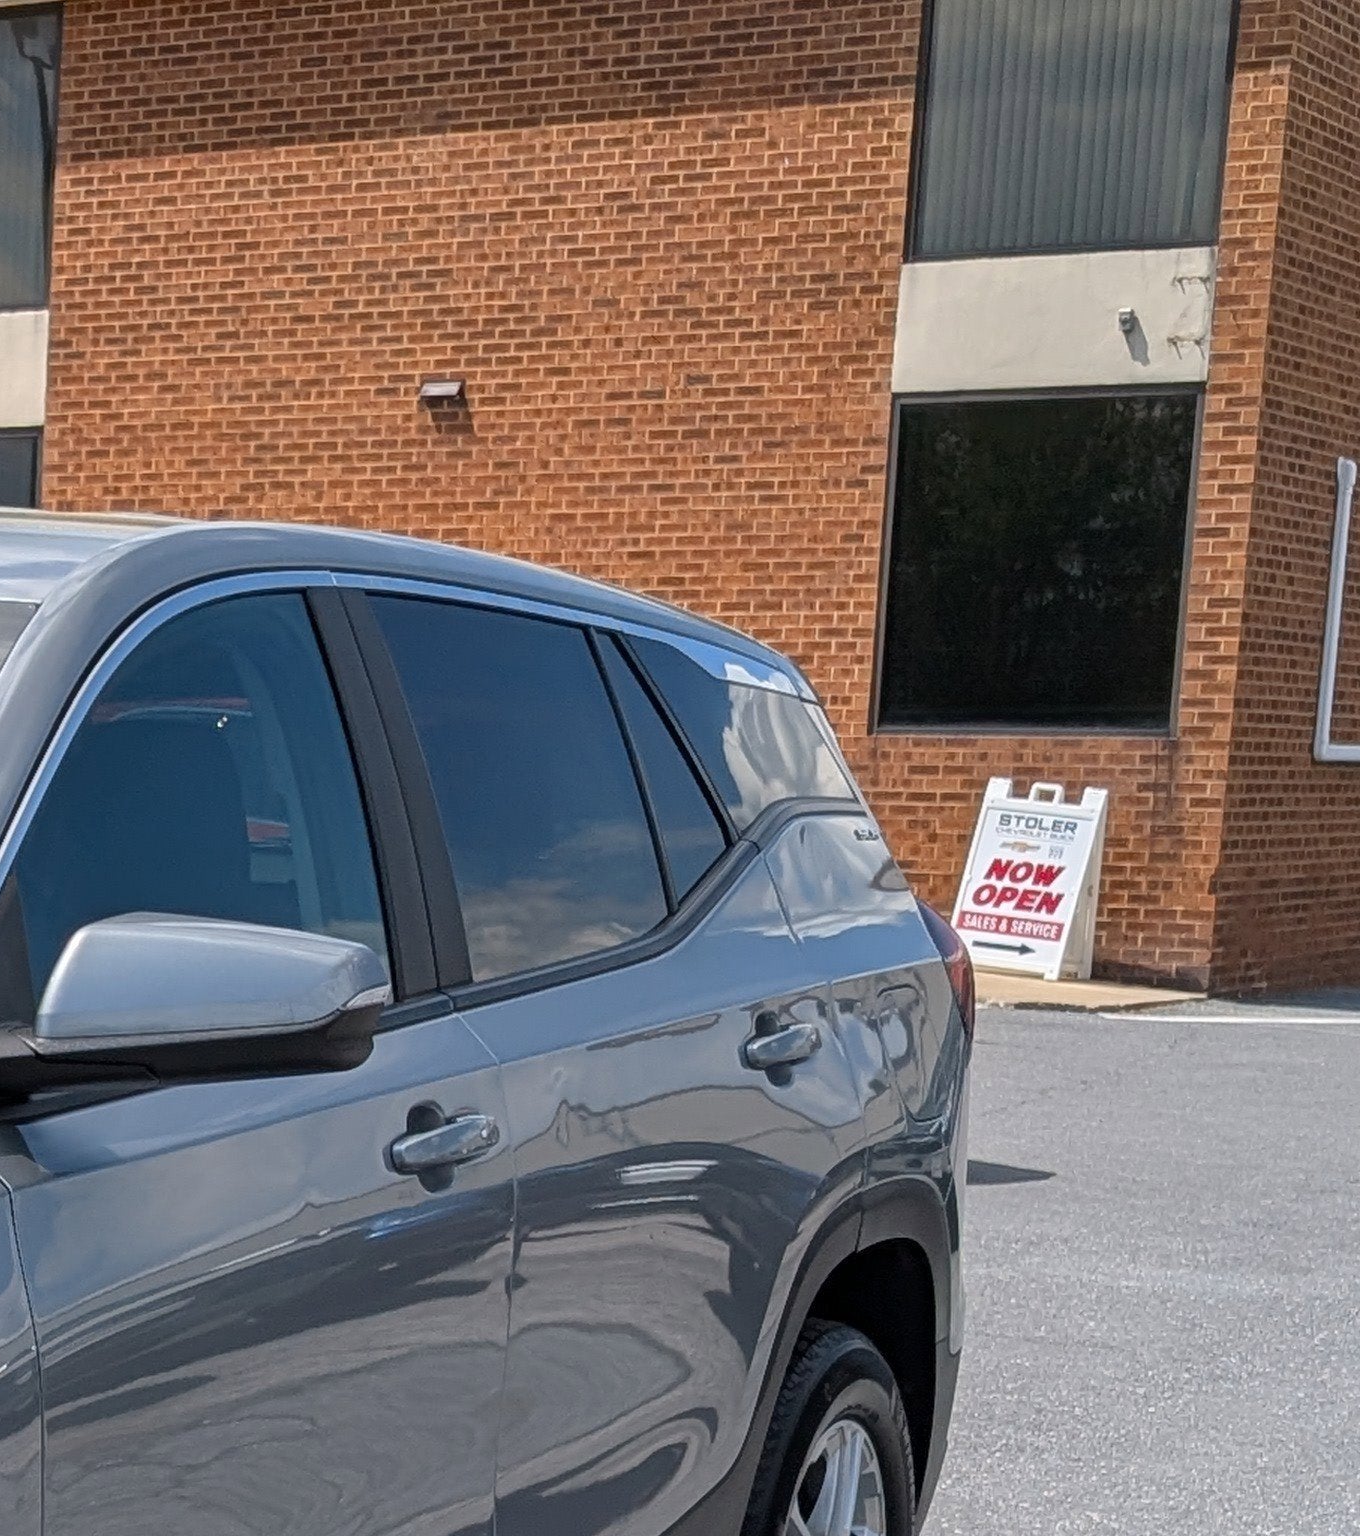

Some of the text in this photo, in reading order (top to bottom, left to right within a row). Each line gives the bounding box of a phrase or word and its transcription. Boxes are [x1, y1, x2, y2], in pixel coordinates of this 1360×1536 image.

[999, 814, 1078, 835] STOLER
[984, 858, 1065, 887] NOW
[972, 884, 1065, 915] OPEN
[963, 913, 998, 930] SALES
[1010, 919, 1060, 939] SERVICE
